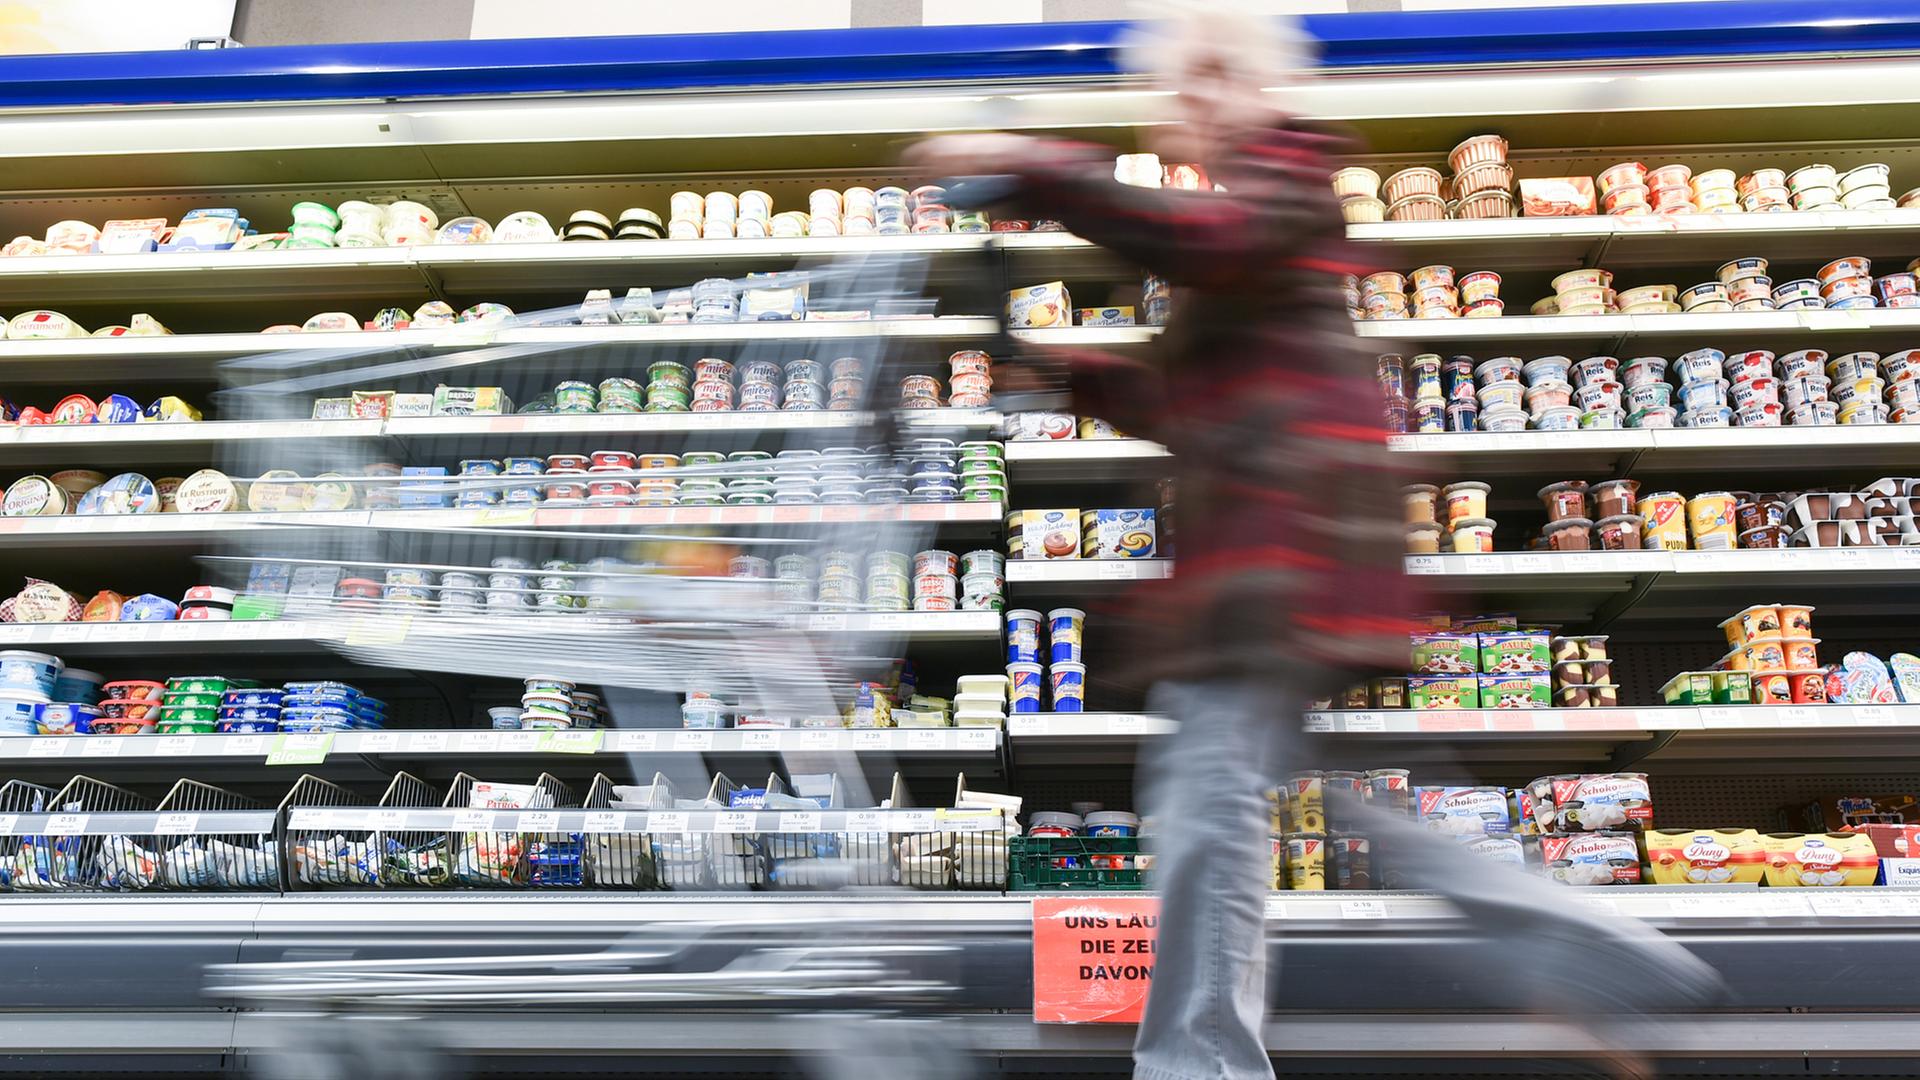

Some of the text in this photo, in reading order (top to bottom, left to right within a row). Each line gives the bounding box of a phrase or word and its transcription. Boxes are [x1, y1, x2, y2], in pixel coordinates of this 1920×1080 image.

[14, 319, 65, 332] Géramont
[1692, 358, 1712, 368] Reis
[1786, 362, 1806, 372] Reis
[1888, 361, 1908, 373] Reis
[706, 364, 732, 376] miree
[1586, 366, 1604, 376] Reis
[1730, 364, 1745, 375] Reis
[448, 391, 477, 400] BRESSO
[744, 386, 773, 396] miree
[1736, 391, 1753, 401] Reis
[1839, 389, 1855, 401] Reis
[1584, 391, 1602, 403] Reis
[1634, 393, 1654, 403] Reis
[1699, 415, 1719, 425] Reis
[1744, 413, 1764, 424] Reis
[190, 487, 228, 498] RUSTIQUE
[1431, 640, 1460, 651] PAULA
[1501, 640, 1532, 651] PAULA
[1428, 682, 1459, 692] PAULA
[1500, 681, 1531, 691] PAULA
[1581, 784, 1618, 797] Schoko
[487, 798, 520, 809] PATROS
[1444, 796, 1479, 809] Schoko
[598, 812, 614, 820] 1.99
[1570, 842, 1607, 855] Schoko
[1689, 846, 1725, 859] Dany
[1801, 849, 1836, 863] Dany
[1065, 913, 1158, 929] UNS LÄU
[1081, 940, 1157, 954] DIE ZEI
[1080, 966, 1154, 980] DAVON
